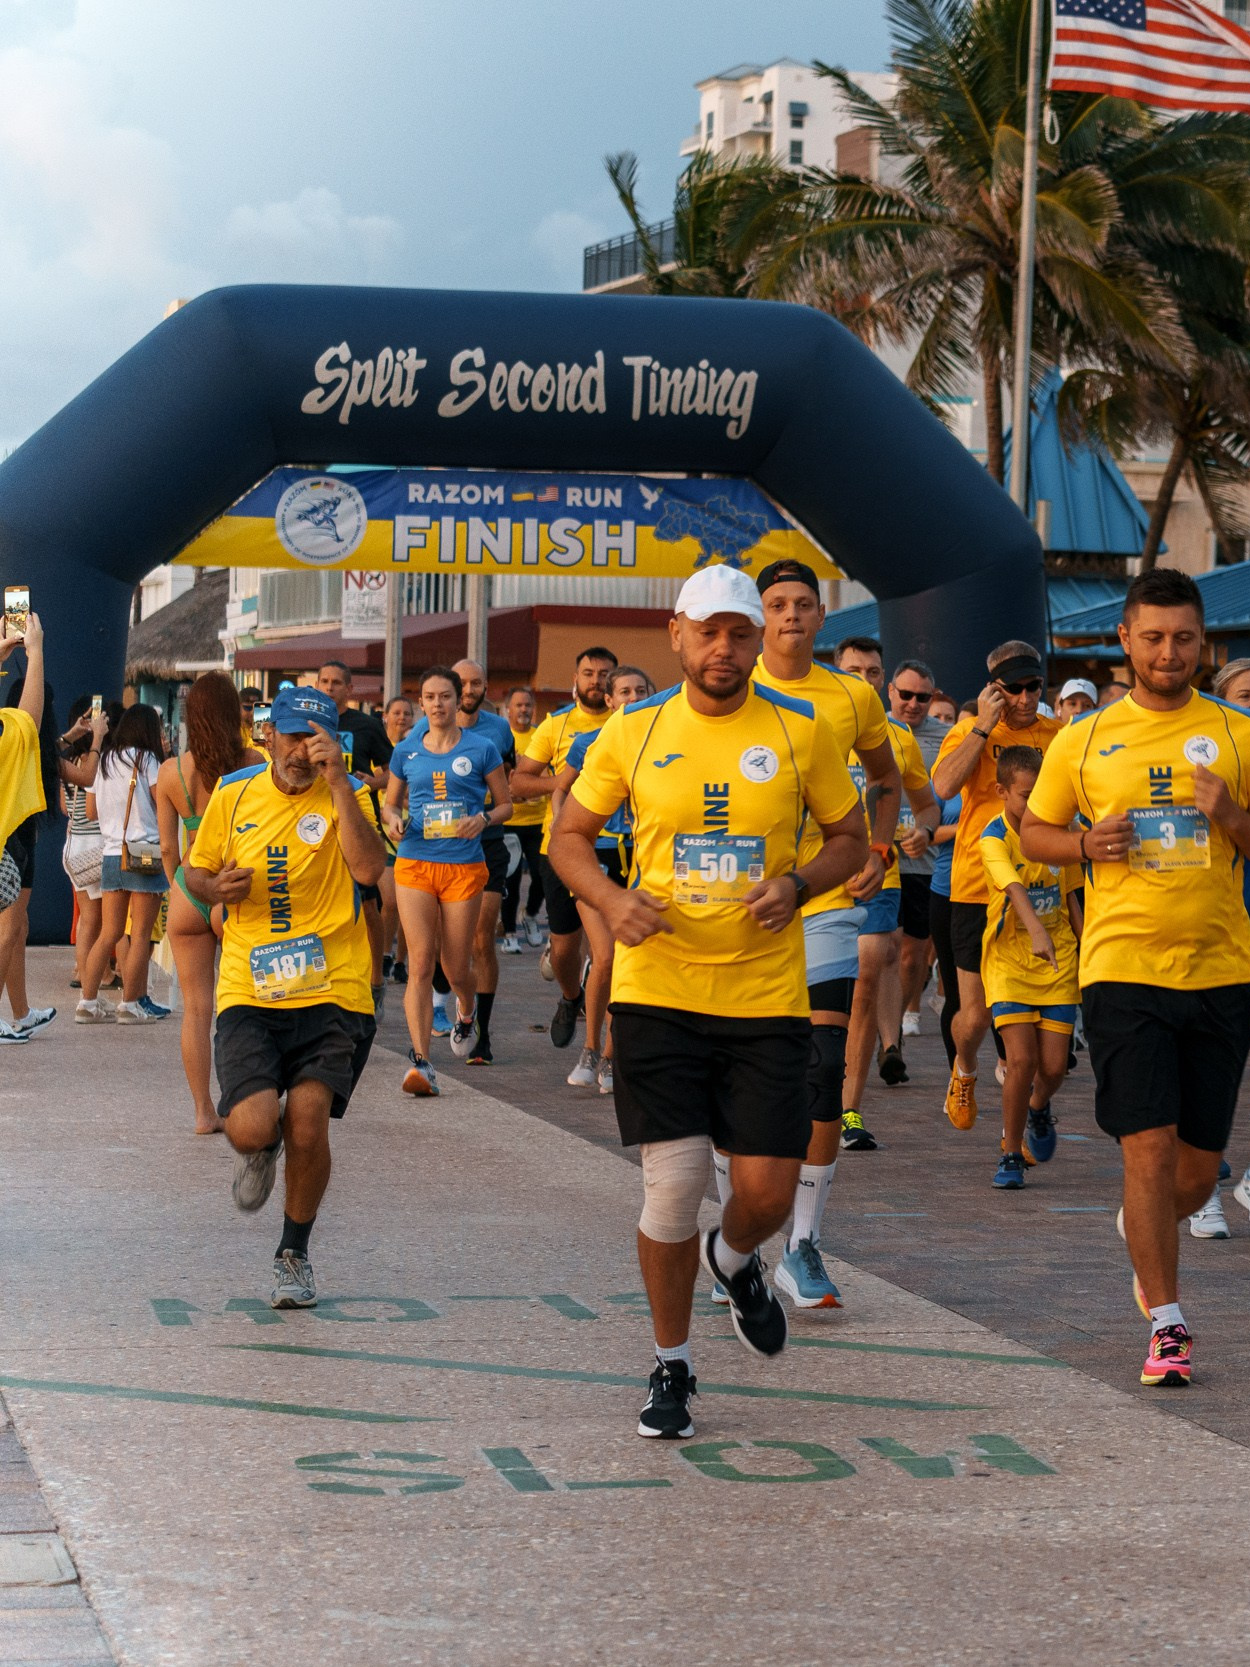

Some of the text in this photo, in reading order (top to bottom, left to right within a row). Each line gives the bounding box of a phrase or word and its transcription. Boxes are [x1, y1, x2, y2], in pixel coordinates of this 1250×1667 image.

[301, 341, 759, 440] Split Second Timing
[408, 483, 622, 508] RAZOM RUN
[392, 514, 637, 567] FINISH
[439, 810, 453, 826] 17
[1133, 808, 1200, 819] RAZOM RUN
[683, 838, 758, 848] RAZOM RUN
[1159, 822, 1177, 849] 3
[700, 853, 738, 882] 50
[267, 846, 292, 933] UKRAINE
[1035, 896, 1054, 916] 22
[254, 938, 314, 956] RAZOM RUN
[268, 951, 307, 981] 187
